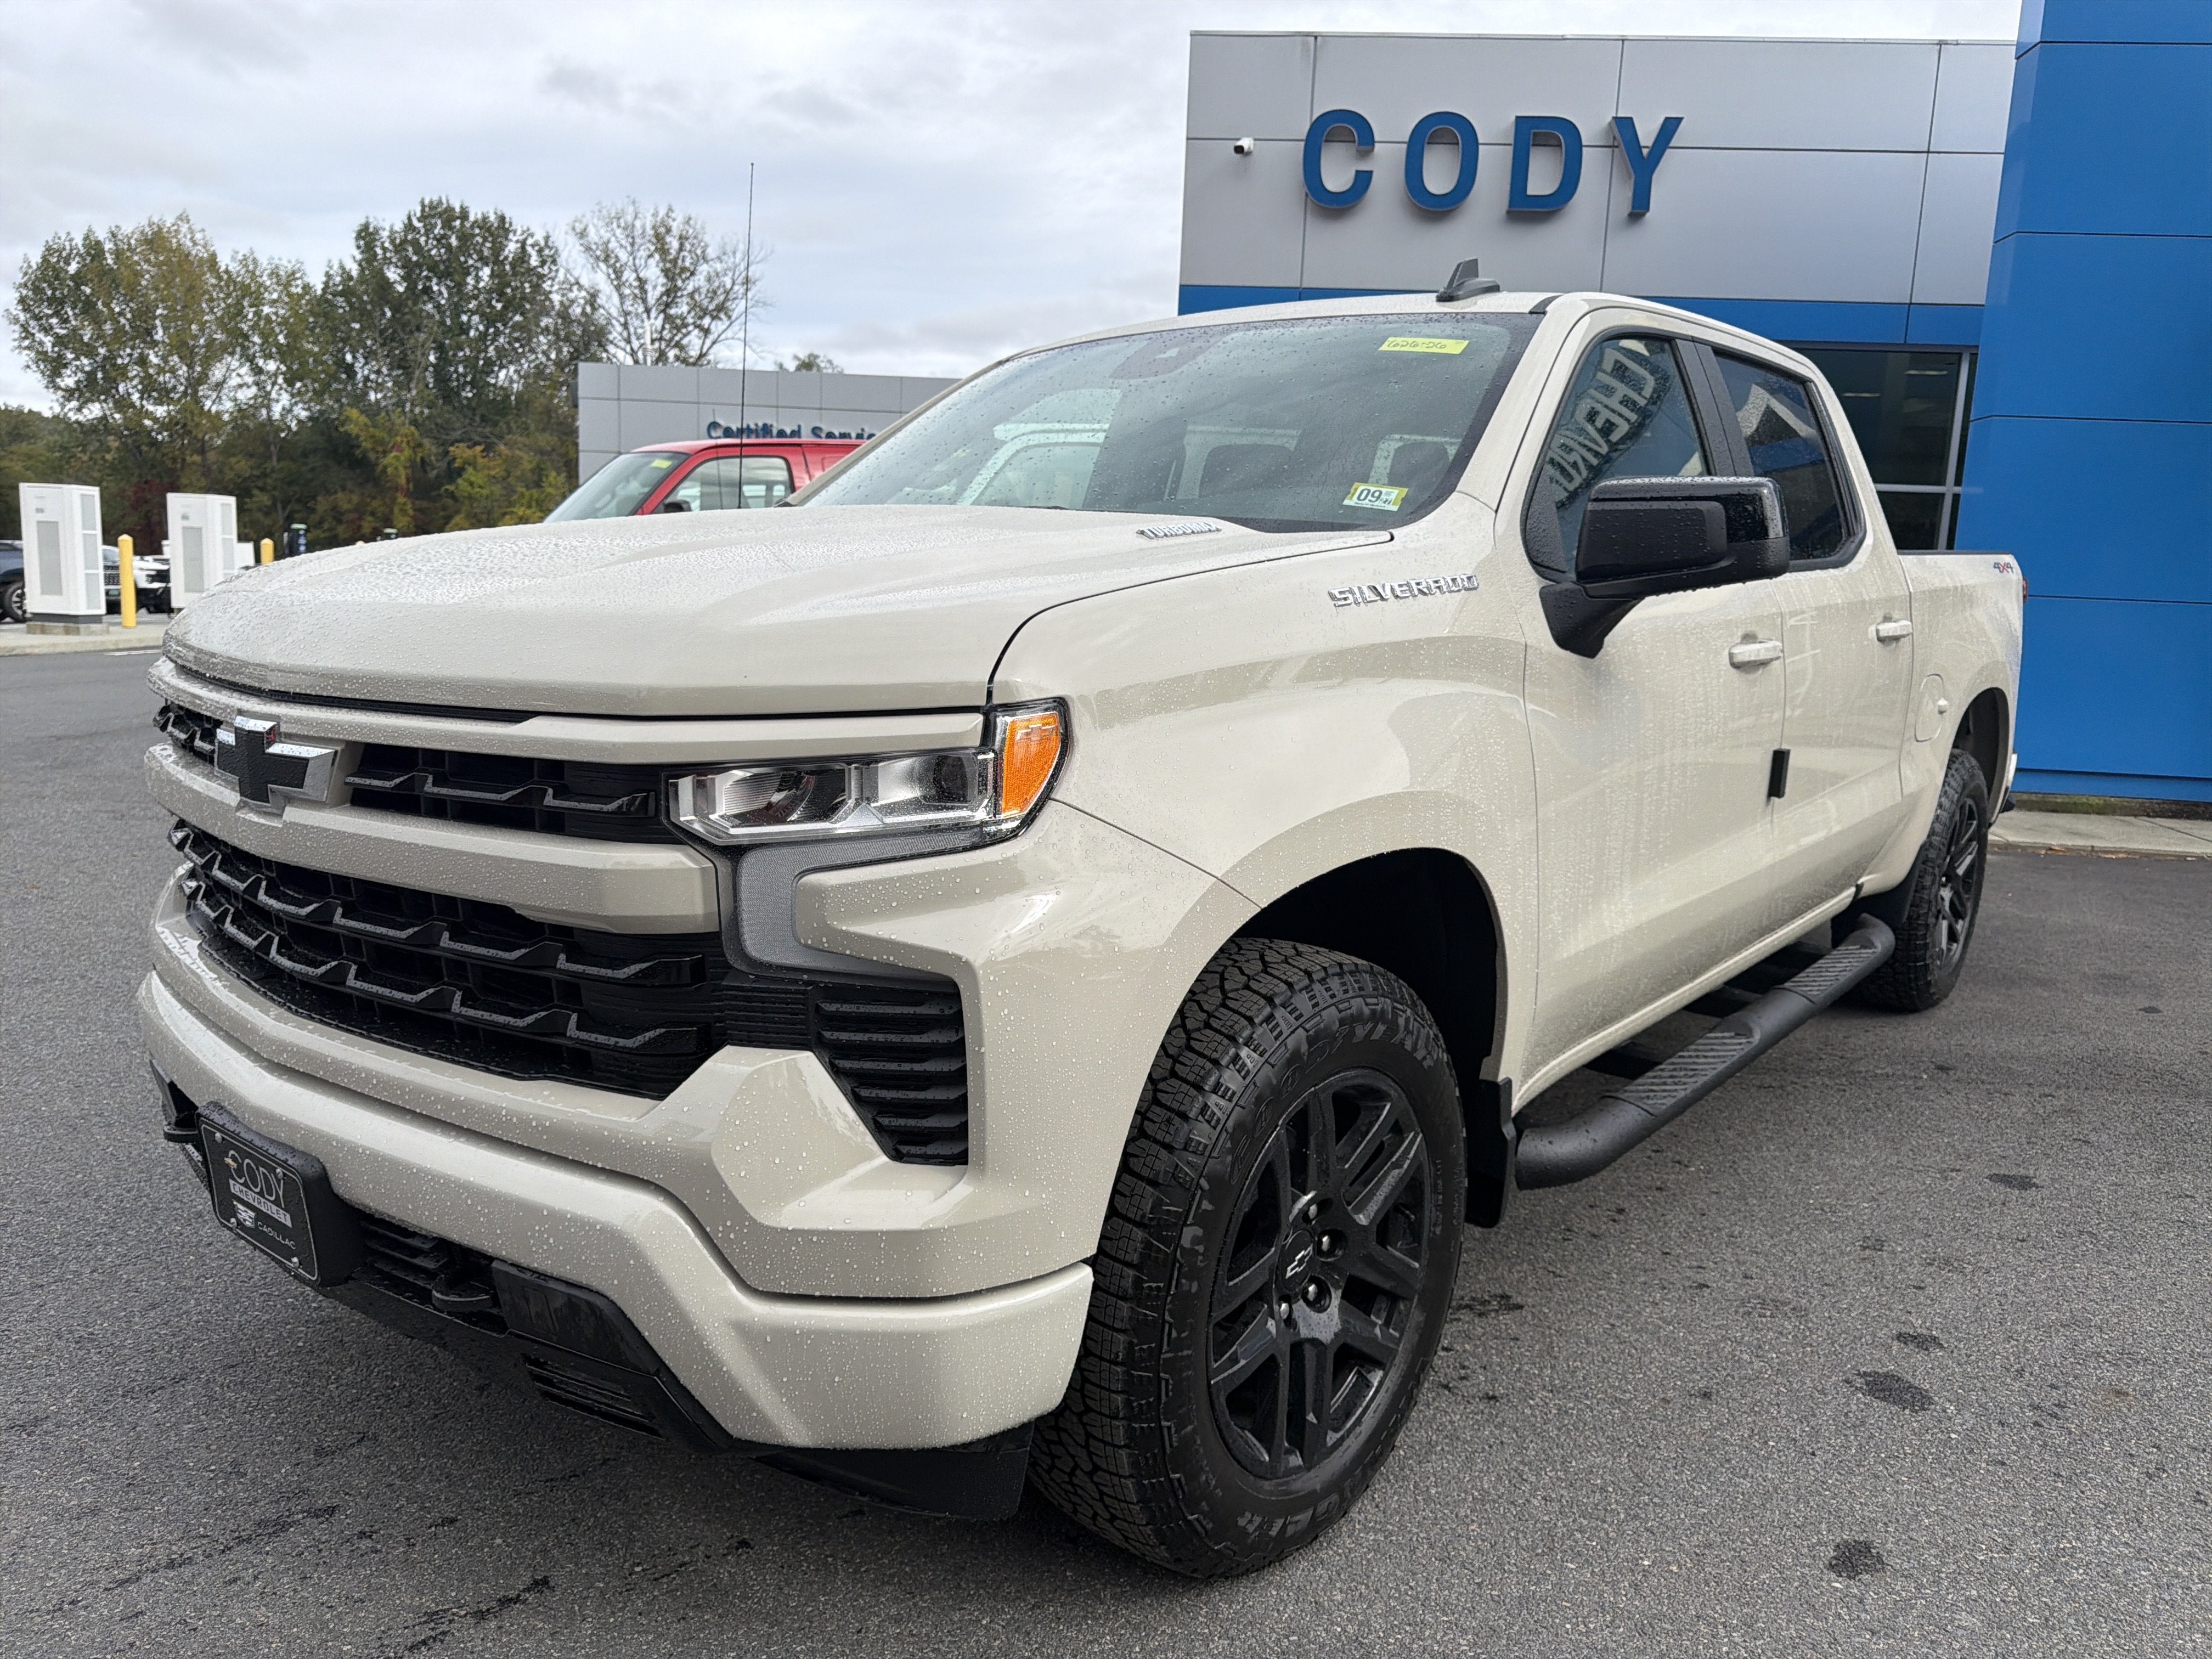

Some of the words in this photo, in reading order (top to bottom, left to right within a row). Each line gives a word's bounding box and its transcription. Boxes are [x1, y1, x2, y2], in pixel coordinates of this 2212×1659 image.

[1302, 109, 1684, 217] CODY
[707, 421, 802, 439] Certified
[1357, 488, 1383, 503] 09
[1136, 521, 1222, 539] TURBOMAX
[1328, 574, 1479, 607] SILVERADO
[228, 1150, 285, 1208] CODY
[233, 1182, 288, 1223] CHEVROLET
[257, 1221, 296, 1250] CADILLAC
